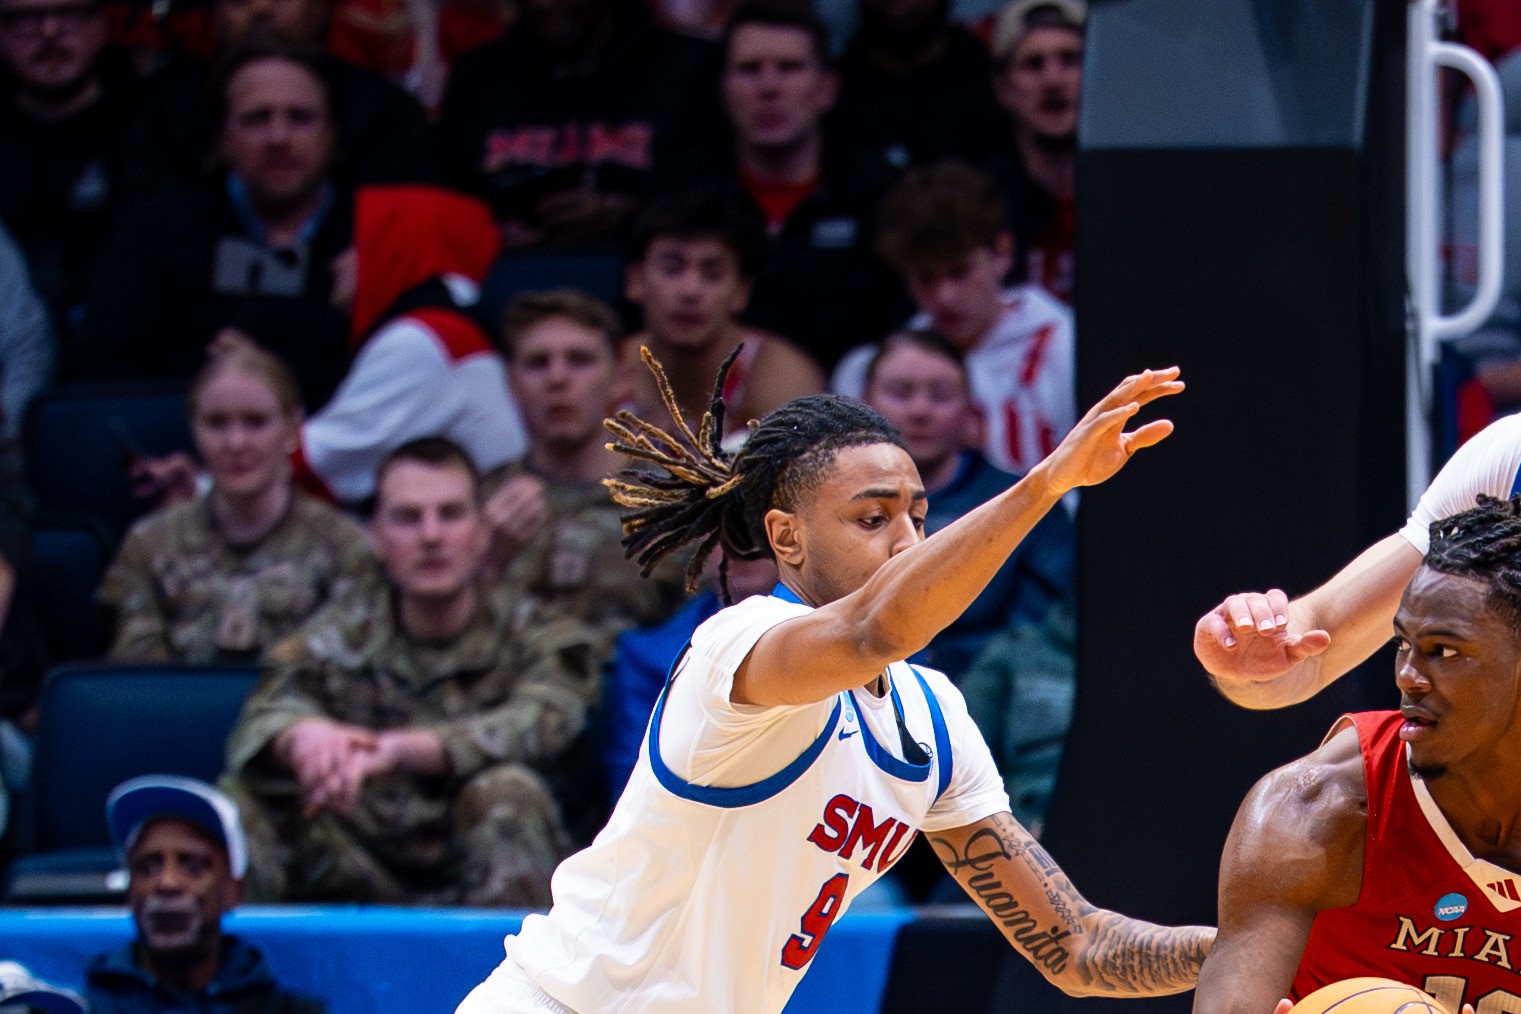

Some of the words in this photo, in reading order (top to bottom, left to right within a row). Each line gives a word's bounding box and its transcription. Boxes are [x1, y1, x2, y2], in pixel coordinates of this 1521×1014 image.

[806, 793, 920, 875] SMU
[780, 872, 850, 971] 9
[930, 827, 1071, 976] Juanita
[1437, 905, 1466, 917] NCAA
